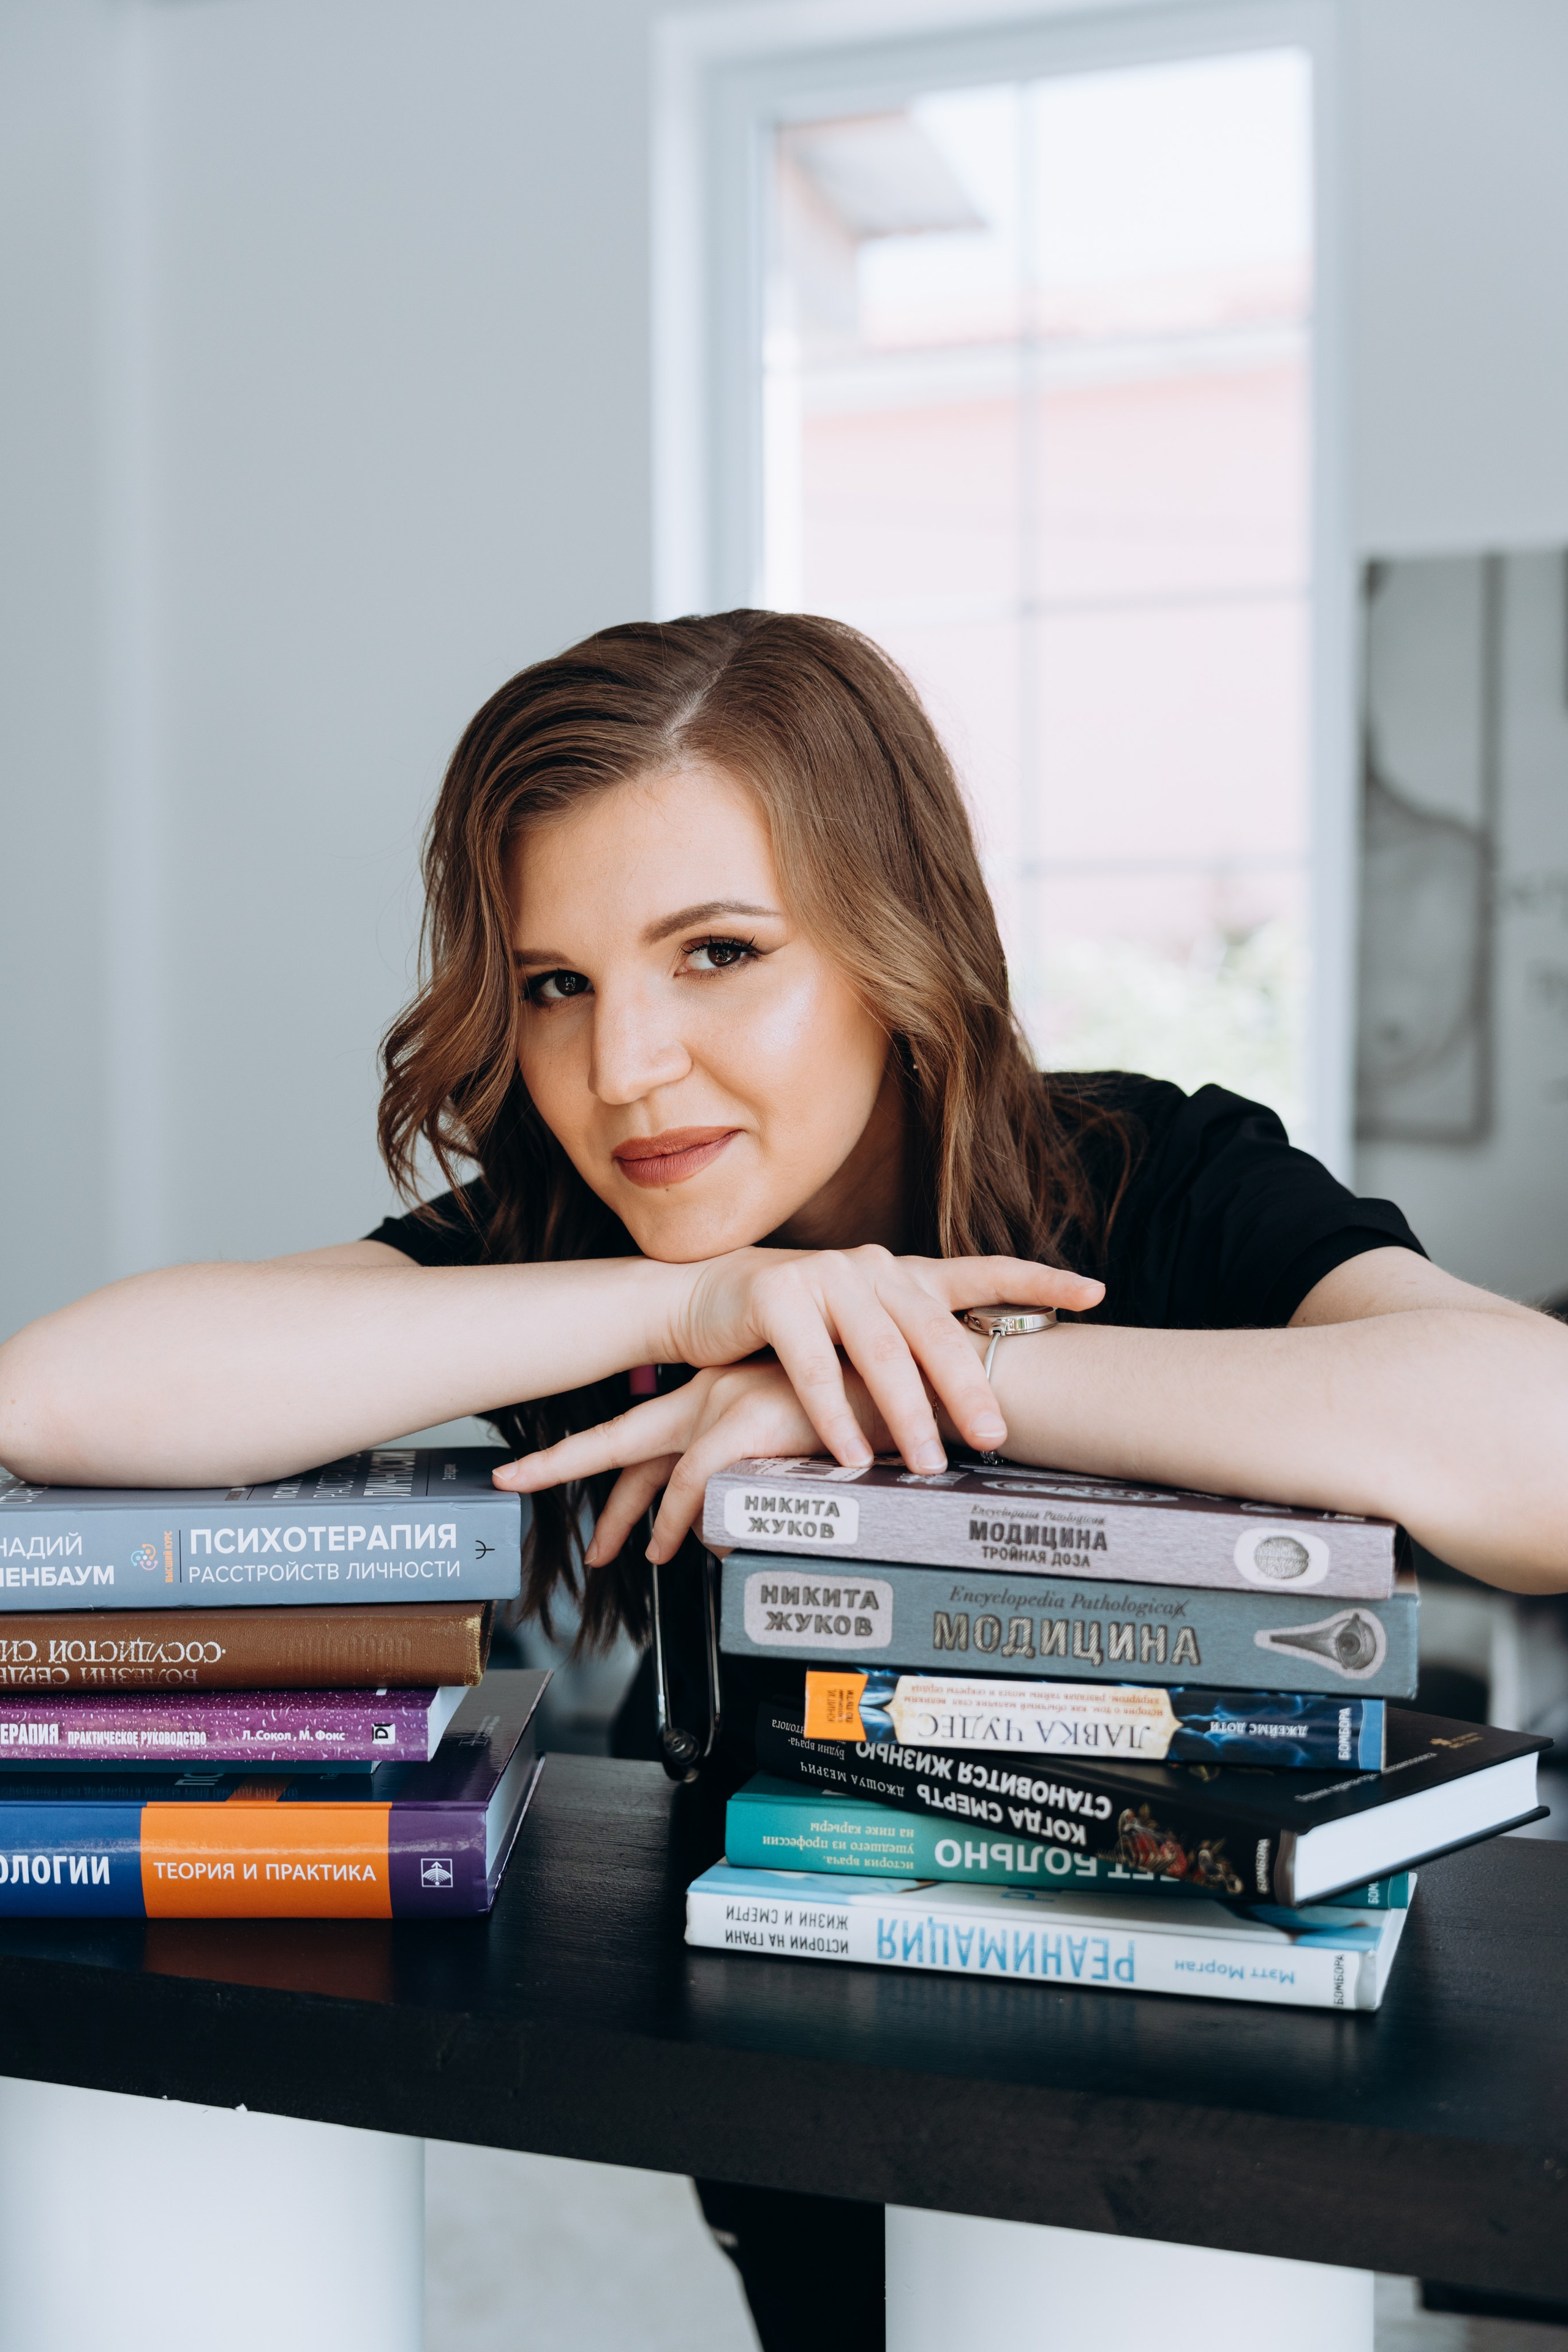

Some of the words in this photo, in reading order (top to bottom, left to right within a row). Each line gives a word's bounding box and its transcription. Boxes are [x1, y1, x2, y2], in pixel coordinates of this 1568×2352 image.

[744, 1496, 840, 1517] НИКИТА
[747, 1517, 834, 1539] ЖУКОВ
[969, 1520, 1107, 1551] МОДИЦИНА
[164, 1531, 173, 1549] КУРС
[190, 1523, 457, 1555] ПСИХОТЕРАПИЯ
[981, 1545, 1047, 1563] ТРОЙНАЯ
[1051, 1551, 1090, 1567] ДОЗА
[0, 1566, 115, 1587] ЕНБАУМ
[164, 1550, 173, 1583] ВЫСШИЙ
[189, 1561, 339, 1583] РАССТРОЙСТВ
[346, 1560, 460, 1580] ЛИЧНОСТИ
[760, 1585, 879, 1610] НИКИТА
[764, 1611, 873, 1636] ЖУКОВ
[933, 1610, 1201, 1666] МОДИЦИНА
[48, 1637, 222, 1664] СОСУДИСТОЙ
[80, 1667, 200, 1684] БОЛЕЗНИ
[911, 1684, 943, 1693] сердца
[946, 1686, 986, 1695] секреты
[1030, 1692, 1060, 1701] тайны
[1064, 1692, 1106, 1702] разгадав
[1020, 1703, 1067, 1713] обычный
[1124, 1706, 1163, 1716] история
[0, 1724, 59, 1745] ЕРАПИЯ
[68, 1731, 138, 1746] ПРАКТИЧЕСКОЕ
[141, 1732, 207, 1746] РУКОВОДСТВО
[300, 1730, 314, 1741] М.
[315, 1730, 345, 1741] Фокс
[919, 1711, 1024, 1741] ЧУДЕС
[1035, 1720, 1151, 1749] ЛАВКА
[1210, 1721, 1247, 1735] ДОТИ
[1249, 1724, 1308, 1739] ДЖЕЙМС
[1338, 1707, 1352, 1760] БОМБОРА
[788, 1737, 815, 1751] врача-
[818, 1744, 845, 1760] Будни
[856, 1742, 954, 1780] ЖИЗНЬЮ
[801, 1762, 847, 1783] МЕЗРИЧ
[851, 1774, 905, 1798] ДЖОШУА
[957, 1762, 1112, 1820] СТАНОВИТСЯ
[917, 1784, 1003, 1823] СМЕРТЬ
[810, 1820, 861, 1835] карьеры
[865, 1826, 895, 1837] пике
[900, 1828, 914, 1838] на
[1008, 1806, 1087, 1845] КОГДА
[763, 1836, 828, 1850] профессии
[832, 1841, 846, 1850] из
[850, 1842, 914, 1855] ушедшего
[864, 1858, 914, 1869] история
[934, 1839, 1098, 1877] БОЛЬНО
[1256, 1839, 1271, 1894] БОМБОРА
[154, 1862, 235, 1880] ТЕОРИЯ
[244, 1863, 257, 1880] И
[266, 1864, 377, 1882] ПРАКТИКА
[726, 1905, 778, 1924] СМЕРТИ
[784, 1910, 793, 1925] И
[799, 1913, 849, 1931] ЖИЗНИ
[725, 1929, 764, 1946] ГРАНИ
[769, 1933, 785, 1948] НА
[791, 1935, 849, 1953] ИСТОРИИ
[876, 1916, 1136, 1983] РЕАНИМАЦИЯ
[1175, 1959, 1244, 1980] Морган
[1251, 1967, 1295, 1985] Мэтт
[1333, 1953, 1345, 2007] БОМБОРА
